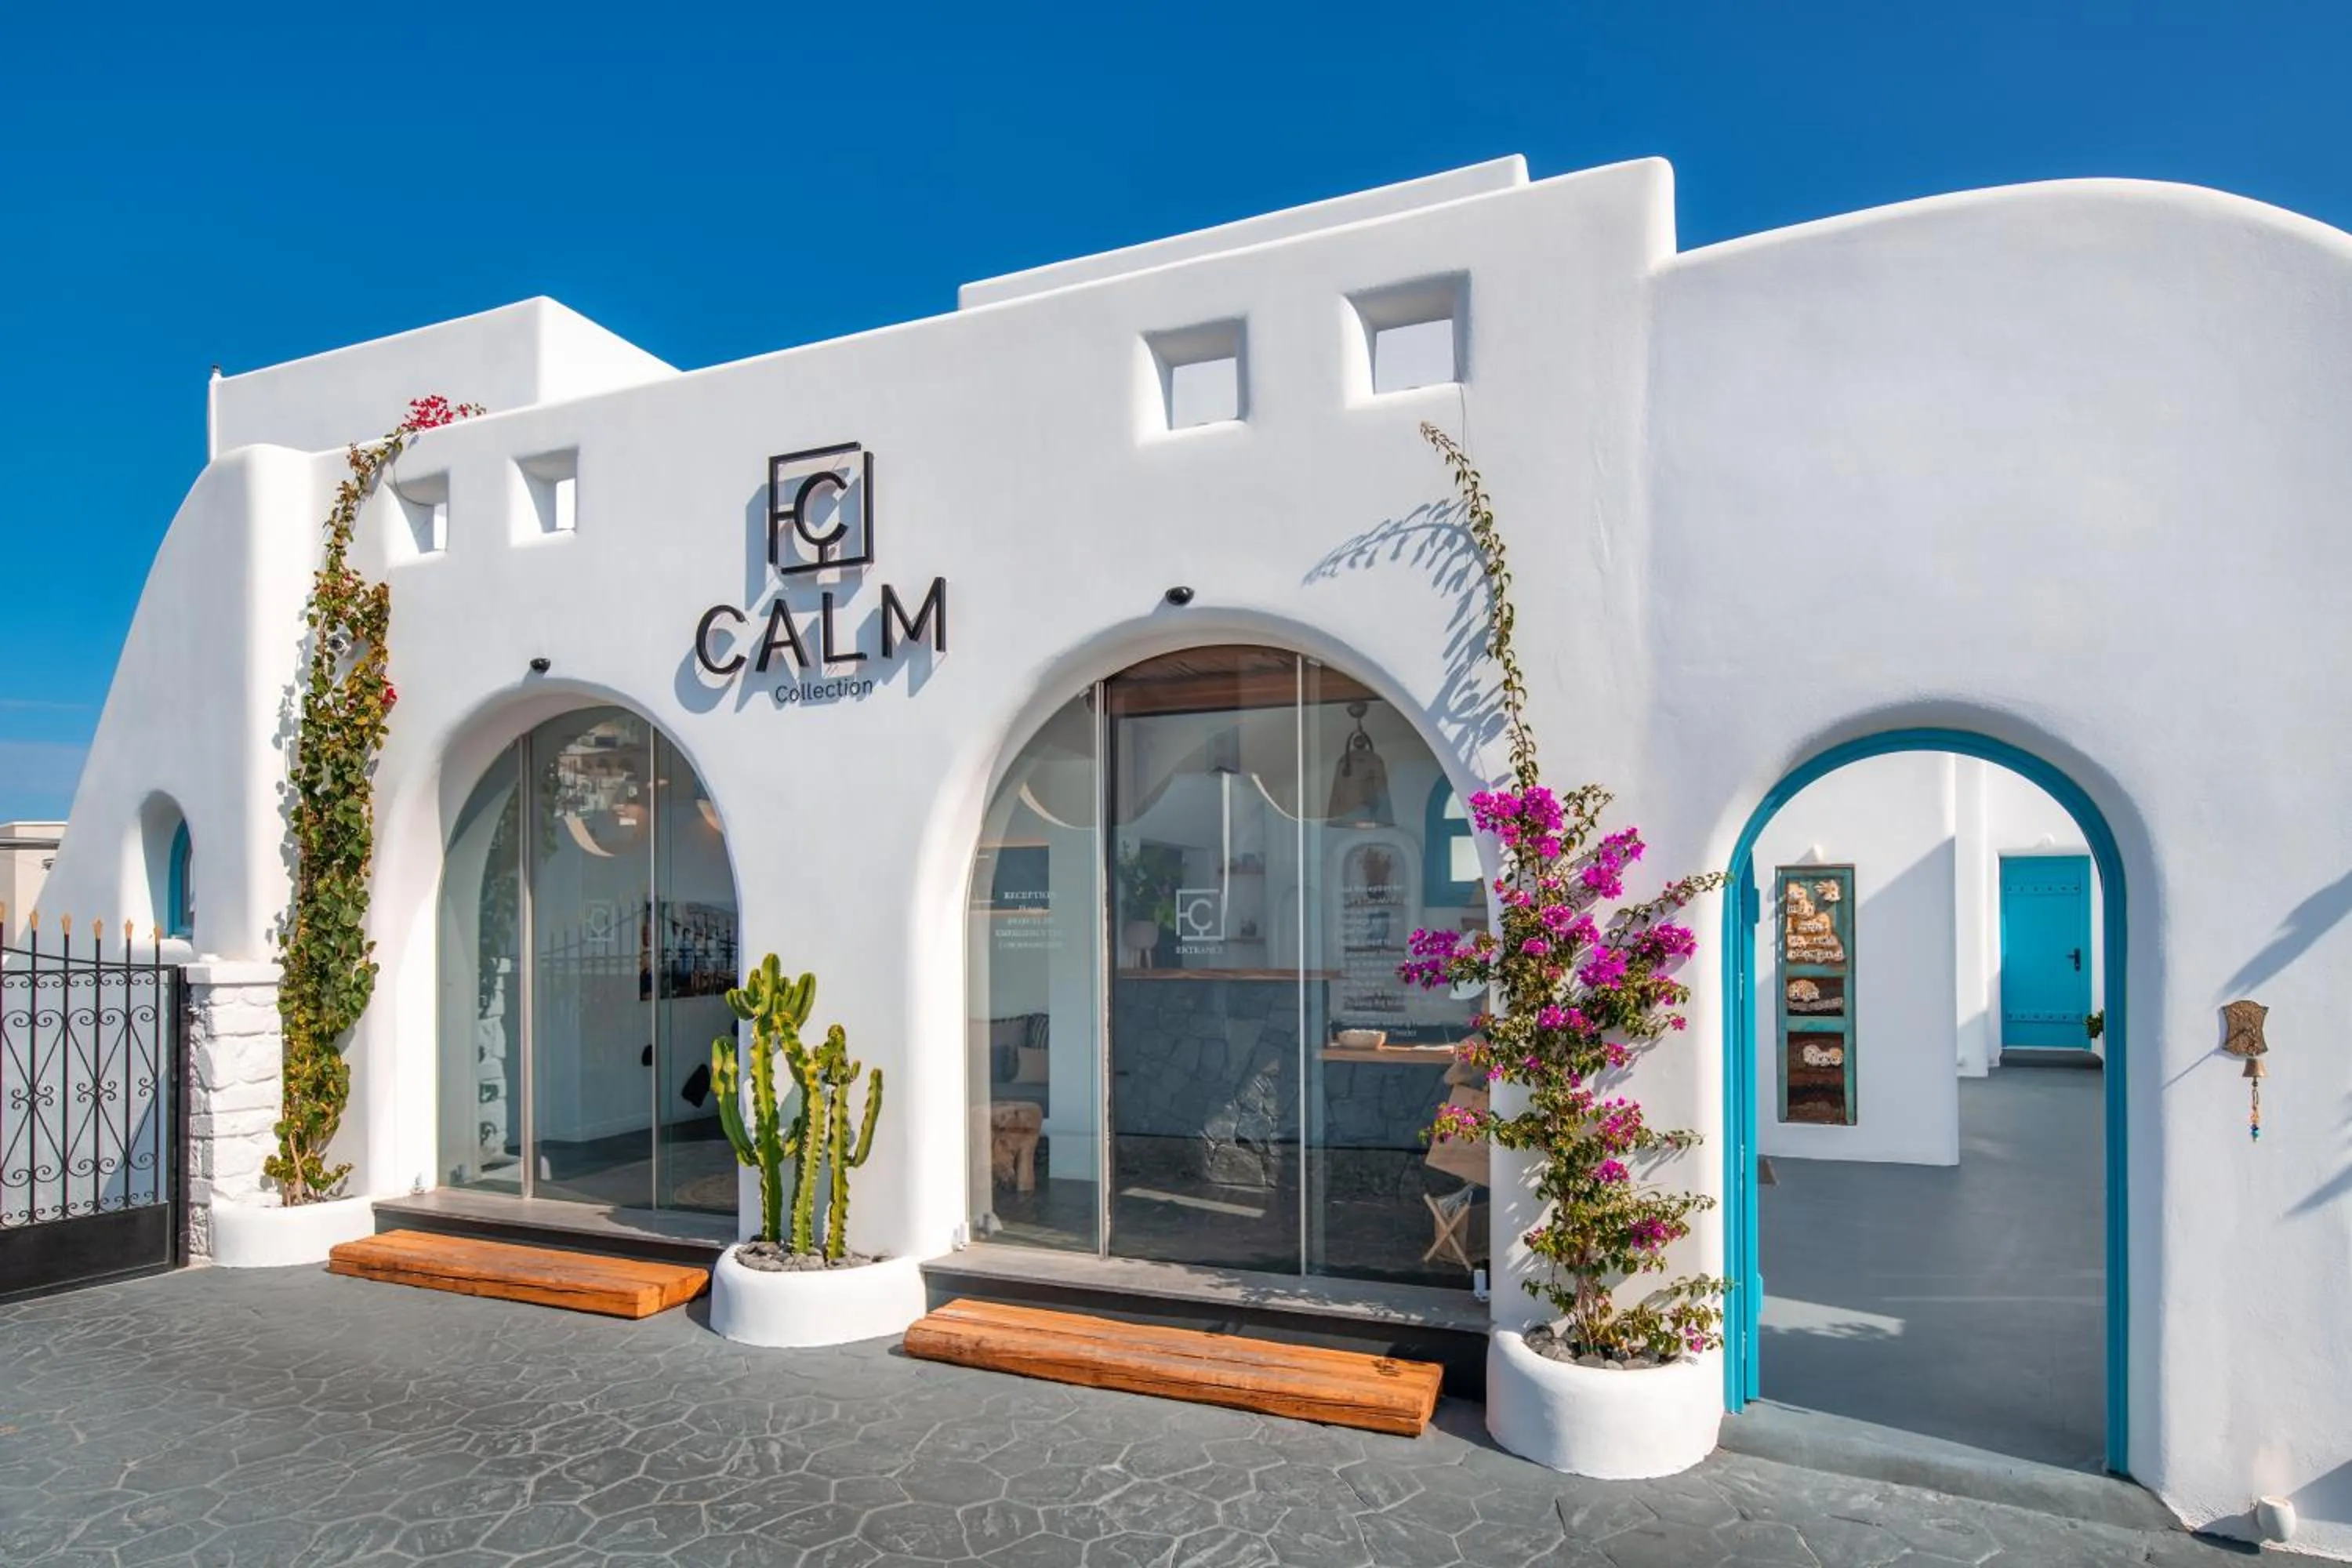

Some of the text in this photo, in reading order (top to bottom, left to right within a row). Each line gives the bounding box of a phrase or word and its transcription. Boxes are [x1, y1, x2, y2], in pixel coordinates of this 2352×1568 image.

[695, 576, 946, 675] CALM
[775, 679, 873, 703] Collection
[1004, 891, 1057, 899] RECEPTION
